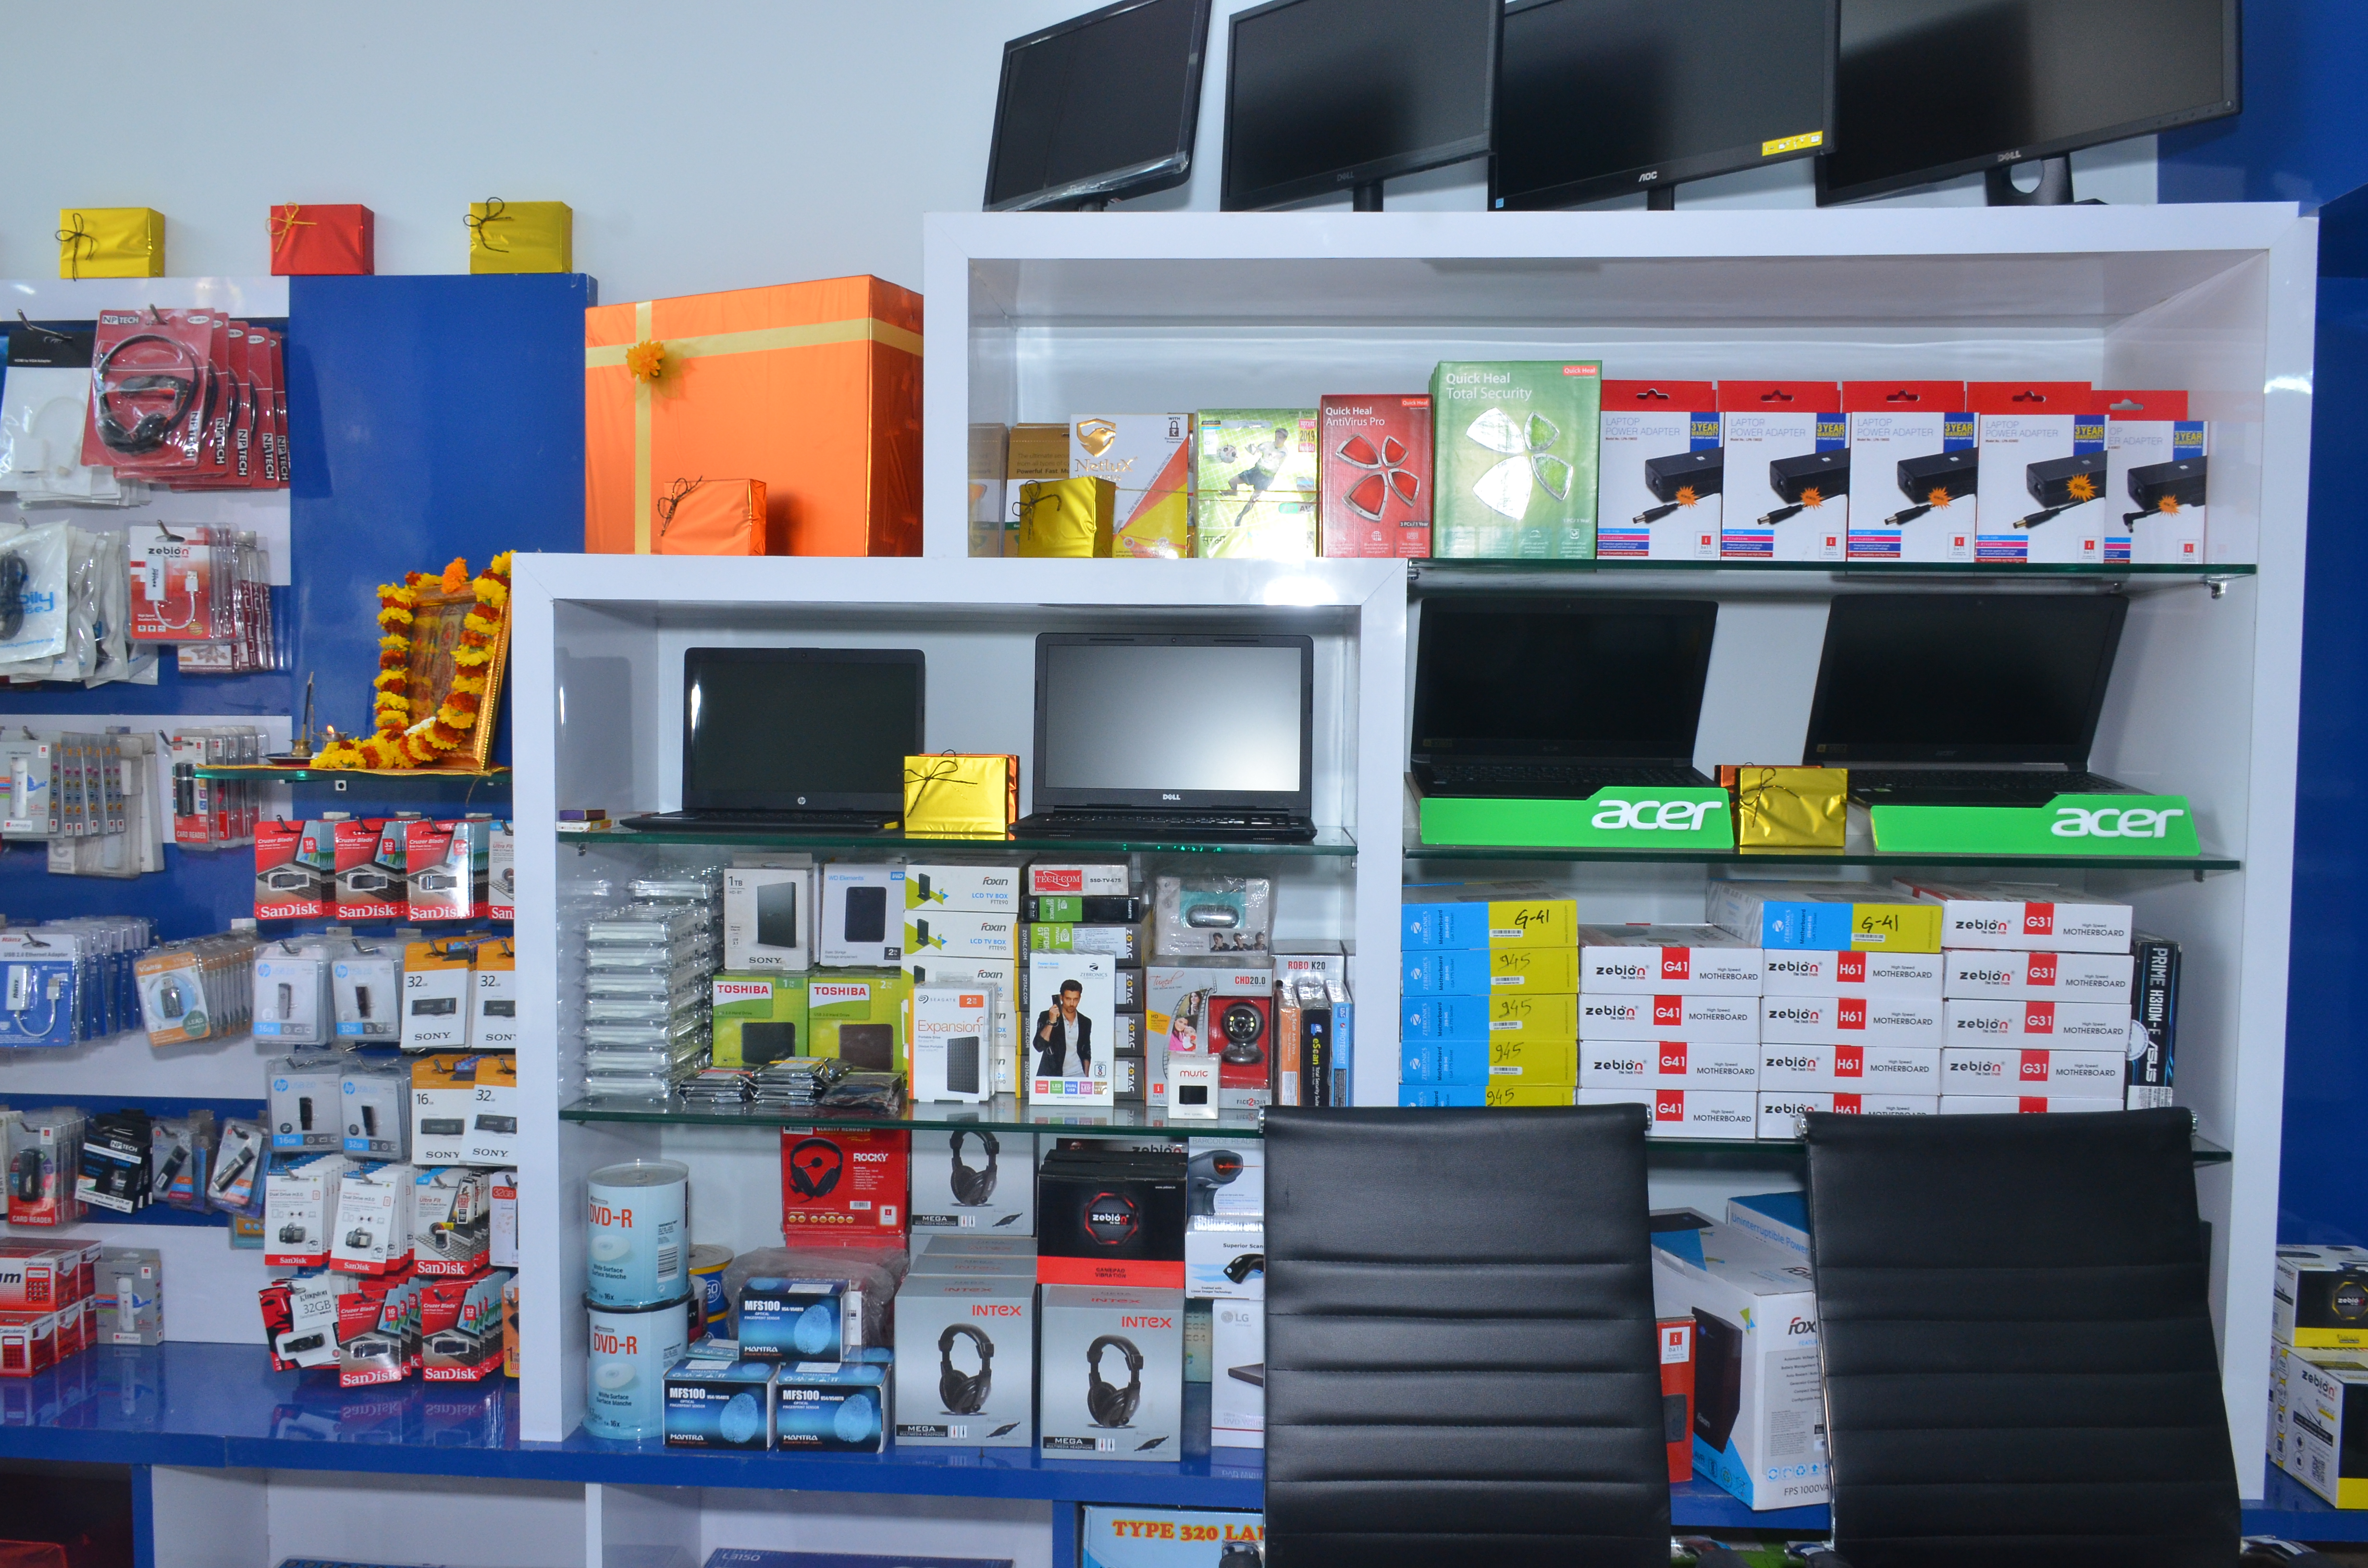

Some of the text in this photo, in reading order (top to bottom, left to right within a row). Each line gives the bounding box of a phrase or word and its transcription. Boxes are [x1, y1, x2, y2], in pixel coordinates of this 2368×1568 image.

[1998, 150, 2022, 162] DELL
[1337, 172, 1354, 182] DELL
[1638, 171, 1658, 183] AOC
[1446, 372, 1510, 385] Quick Heal
[1446, 387, 1532, 401] Total Security
[1326, 407, 1351, 416] Quick
[1326, 417, 1385, 427] AntiVirus Pro
[1605, 417, 1640, 426] LAPTOP
[1986, 420, 2019, 429] LAPTOP
[1640, 428, 1680, 436] ADAPTER
[1691, 423, 1719, 432] 3 YEAR
[2080, 426, 2104, 435] YEAR
[1300, 430, 1315, 442] 2019
[1985, 429, 2059, 438] POWER ADAPTER
[1299, 444, 1315, 452] inside
[1591, 800, 1722, 831] acer
[2050, 808, 2183, 838] acer
[1036, 875, 1081, 884] TECH-COM
[261, 903, 318, 917] SanDisk
[339, 904, 395, 918] SanDisk
[411, 906, 467, 919] SanDisk
[1956, 919, 2007, 931] zebion
[2026, 917, 2051, 928] G31
[2063, 928, 2124, 937] MOTHERBOARD
[1288, 961, 1326, 970] ROBO K20
[1596, 965, 1645, 976] zebion
[1664, 961, 1688, 972] G41
[1768, 962, 1818, 972] zebion
[1839, 964, 1862, 975] H61
[1150, 970, 1184, 987] Tuned
[1873, 970, 1932, 978] MOTHERBOARD
[1960, 970, 2010, 981] zebion
[2030, 968, 2055, 979] G31
[407, 976, 422, 987] 32
[1235, 976, 1266, 985] CHD20.0
[2066, 979, 2125, 987] MOTHERBOARD
[717, 985, 769, 995] TOSHIBA
[814, 986, 866, 996] TOSHIBA
[2146, 947, 2168, 1035] PRIME H310M-E
[1586, 1005, 1635, 1016] zebion
[1656, 1007, 1680, 1018] G41
[1769, 1009, 1819, 1020] zebion
[1689, 1013, 1748, 1021] MOTHERBOARD
[1840, 1011, 1862, 1022] H61
[918, 1019, 981, 1034] Expansion
[415, 1032, 450, 1041] SONY
[1180, 1069, 1208, 1078] music
[416, 1094, 428, 1104] 16
[476, 1090, 491, 1101] 32
[473, 1148, 508, 1157] SONY
[853, 1152, 888, 1163] ROCKY
[493, 1189, 514, 1198] 32GB
[29, 1215, 52, 1224] READER
[590, 1206, 633, 1228] DVD-R
[1092, 1213, 1128, 1222] zebion
[1731, 1211, 1809, 1255] Uninterruptible Power
[418, 1262, 466, 1274] SanDisk
[299, 1290, 328, 1301] Kingston
[303, 1300, 331, 1314] 32GB
[744, 1300, 780, 1312] MFS100
[1235, 1312, 1249, 1323] LG
[593, 1333, 638, 1355] DVD-R
[343, 1371, 398, 1387] SanDisk
[425, 1368, 477, 1379] SanDisk
[2302, 1369, 2335, 1396] zebion
[669, 1388, 705, 1399] MFS100
[1784, 1483, 1829, 1497] FPS 1000VA
[1112, 1520, 1219, 1542] TYPE 320
[721, 1552, 760, 1561] L3150
